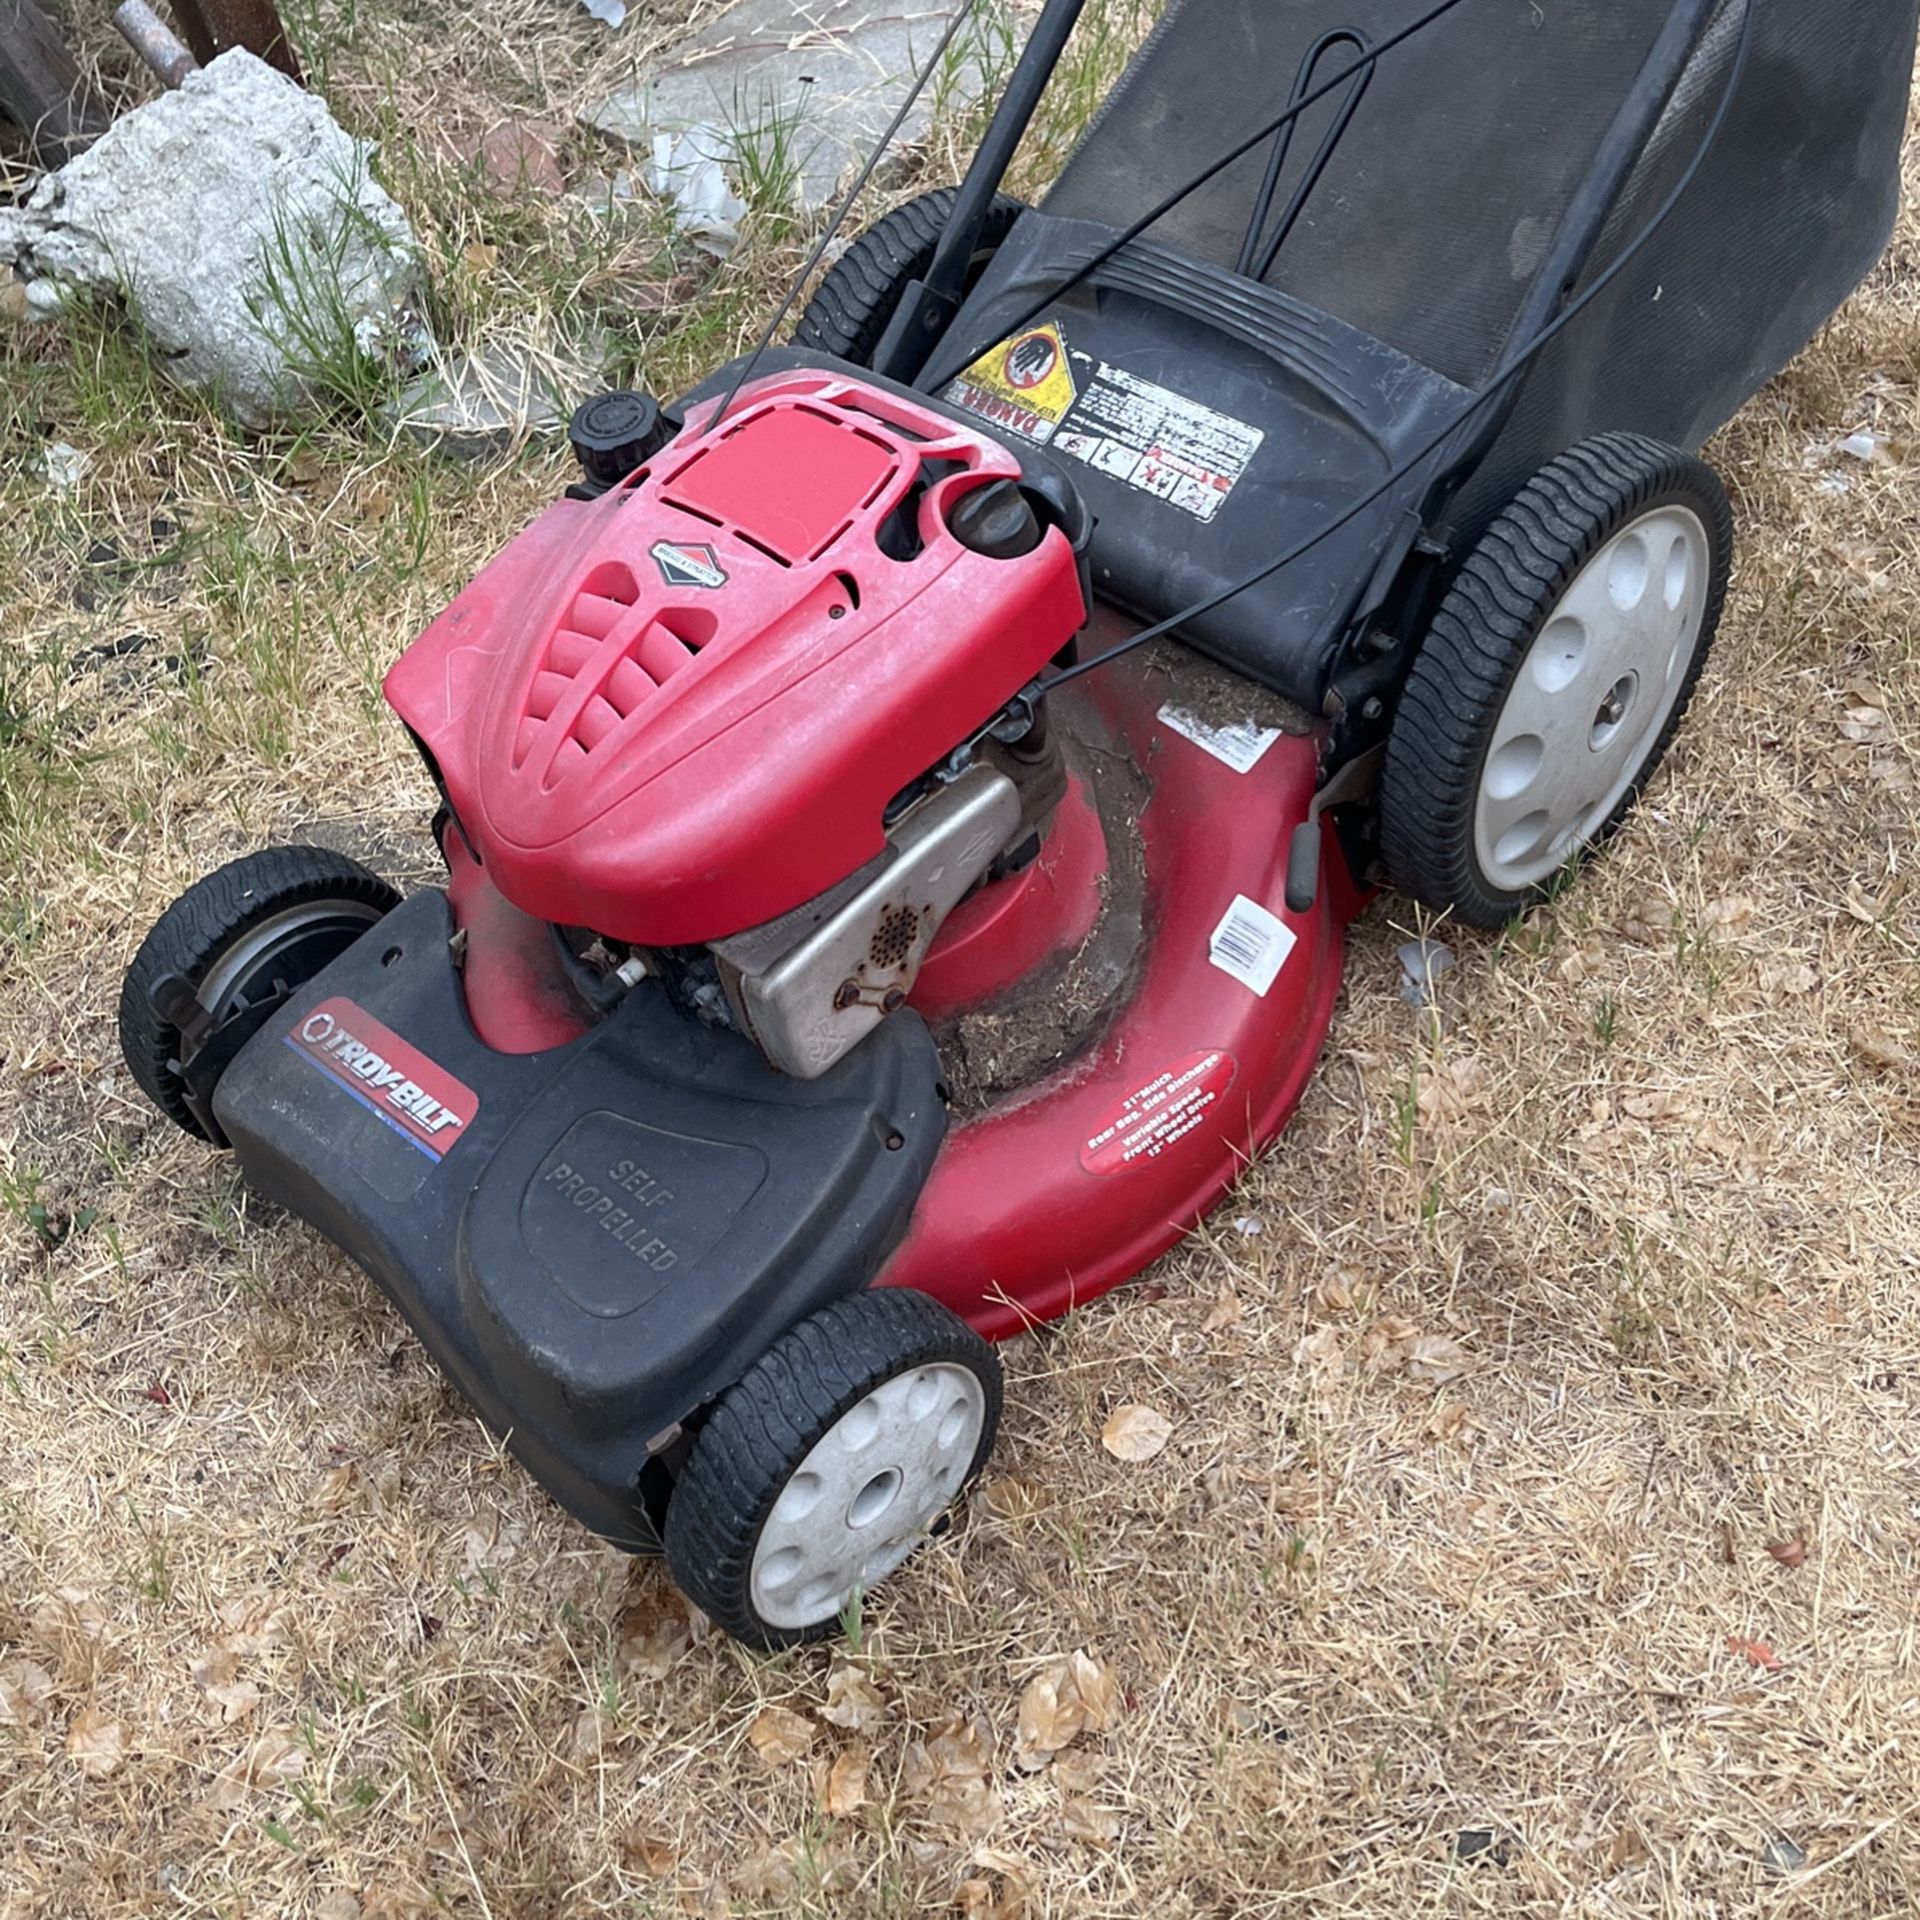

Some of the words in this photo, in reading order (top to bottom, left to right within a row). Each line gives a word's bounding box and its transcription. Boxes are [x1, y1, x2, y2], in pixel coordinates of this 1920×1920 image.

[963, 386, 1040, 434] DANGER
[322, 1028, 463, 1134] TROY-BILT
[1088, 1127, 1115, 1149] Rear
[1142, 1091, 1168, 1111] Side
[1167, 1053, 1219, 1094] Discharge
[1122, 1112, 1169, 1147] Variable
[1168, 1086, 1202, 1115] Speed
[1122, 1136, 1154, 1161] Front
[1154, 1113, 1187, 1139] Wheel
[1186, 1091, 1215, 1114] Drive
[1166, 1113, 1203, 1144] Wheels
[609, 1160, 674, 1207] SELF
[544, 1163, 678, 1271] PROPELLED
